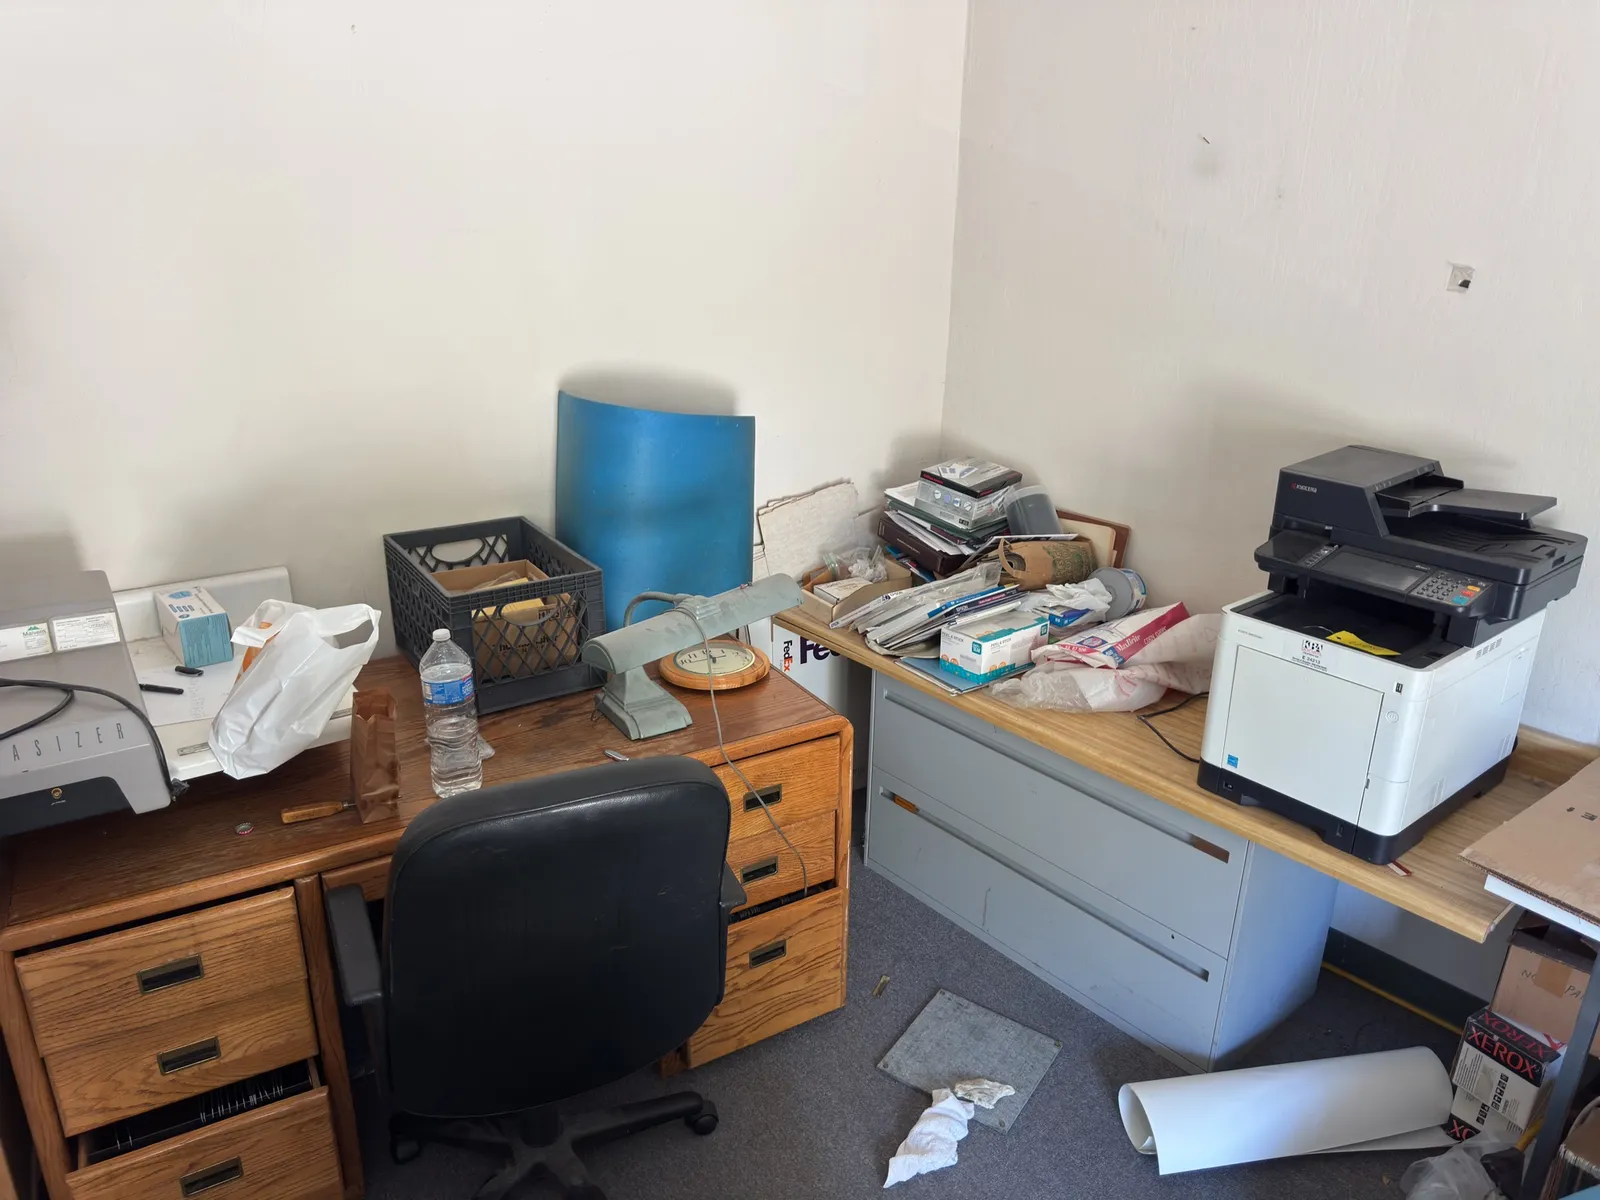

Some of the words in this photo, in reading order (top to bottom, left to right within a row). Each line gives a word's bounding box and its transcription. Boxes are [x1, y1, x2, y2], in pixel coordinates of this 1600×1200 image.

[783, 640, 793, 672] FedEx
[800, 636, 841, 665] Fe
[1467, 1025, 1537, 1080] XEROX
